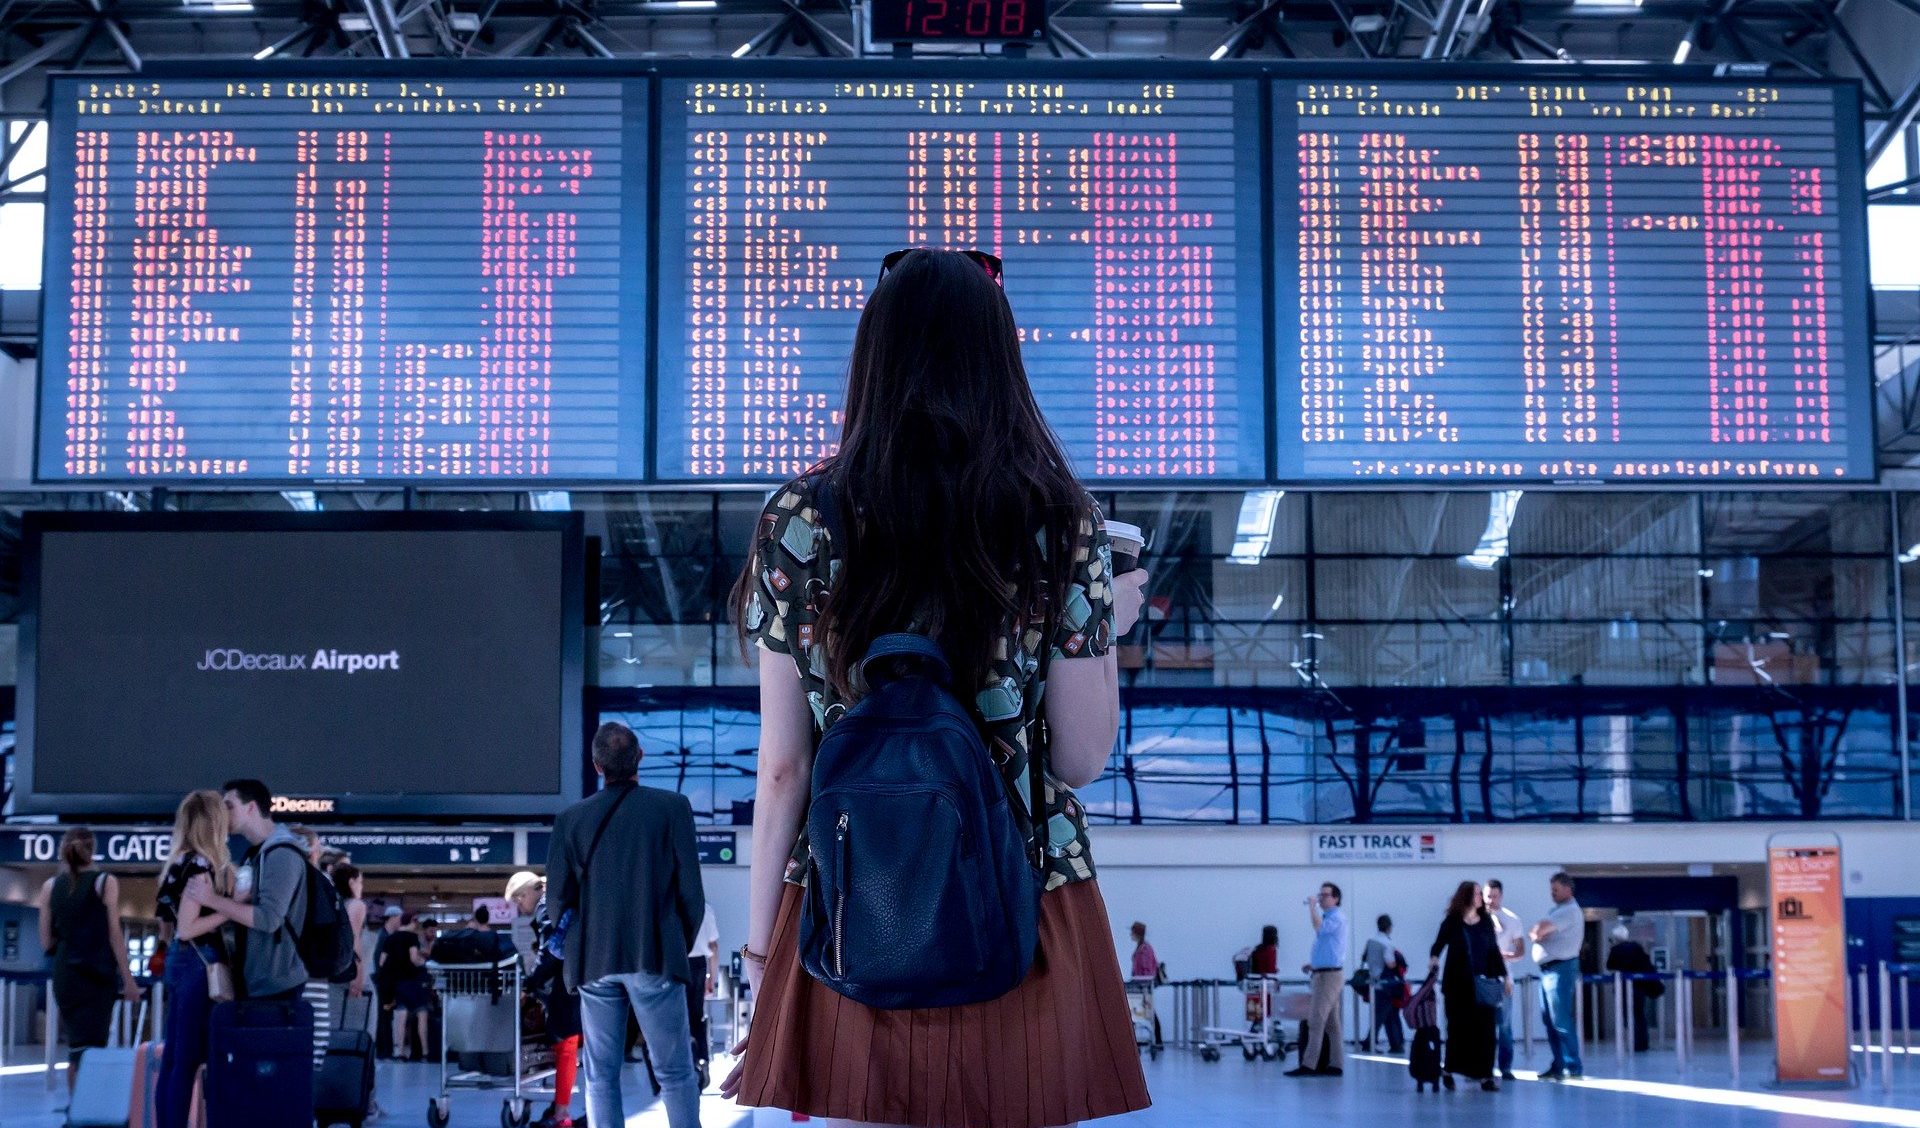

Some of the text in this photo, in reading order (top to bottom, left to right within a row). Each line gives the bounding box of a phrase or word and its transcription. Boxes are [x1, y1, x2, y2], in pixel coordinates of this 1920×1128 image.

[904, 0, 1026, 35] 12:08
[197, 648, 400, 674] JCDecaux Airport
[18, 833, 56, 860] TO
[328, 835, 348, 845] YOUR
[349, 835, 387, 845] PASSPORT
[388, 835, 404, 845] AND
[405, 835, 443, 845] BOARDING
[444, 835, 463, 845] PASS
[464, 835, 490, 845] READY
[1319, 835, 1411, 849] FAST TRACK
